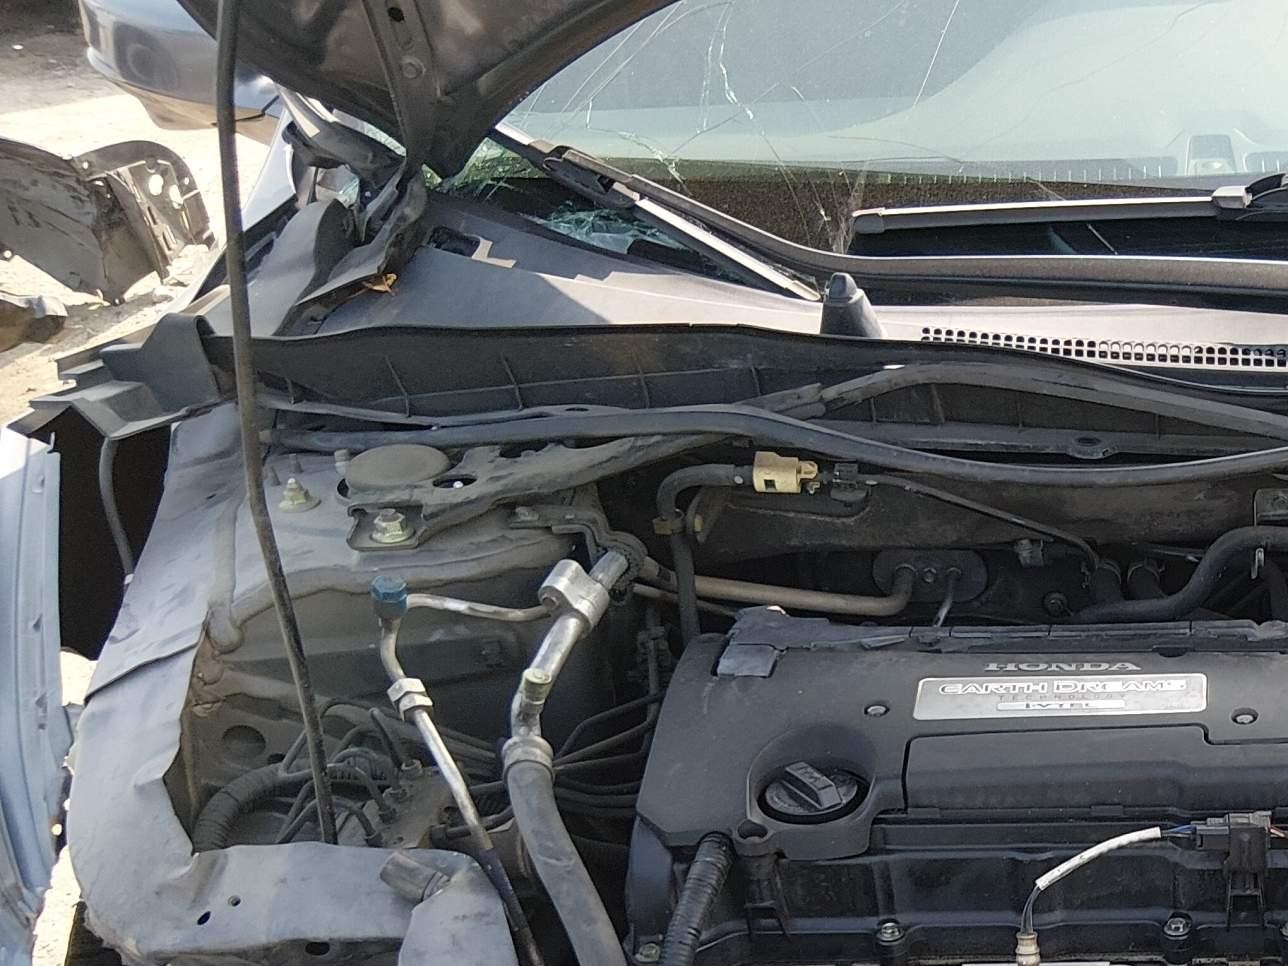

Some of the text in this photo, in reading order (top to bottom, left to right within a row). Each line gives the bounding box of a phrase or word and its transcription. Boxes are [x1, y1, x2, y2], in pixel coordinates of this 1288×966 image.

[984, 662, 1142, 671] HONDA
[939, 680, 1187, 694] EARTH DREAMS
